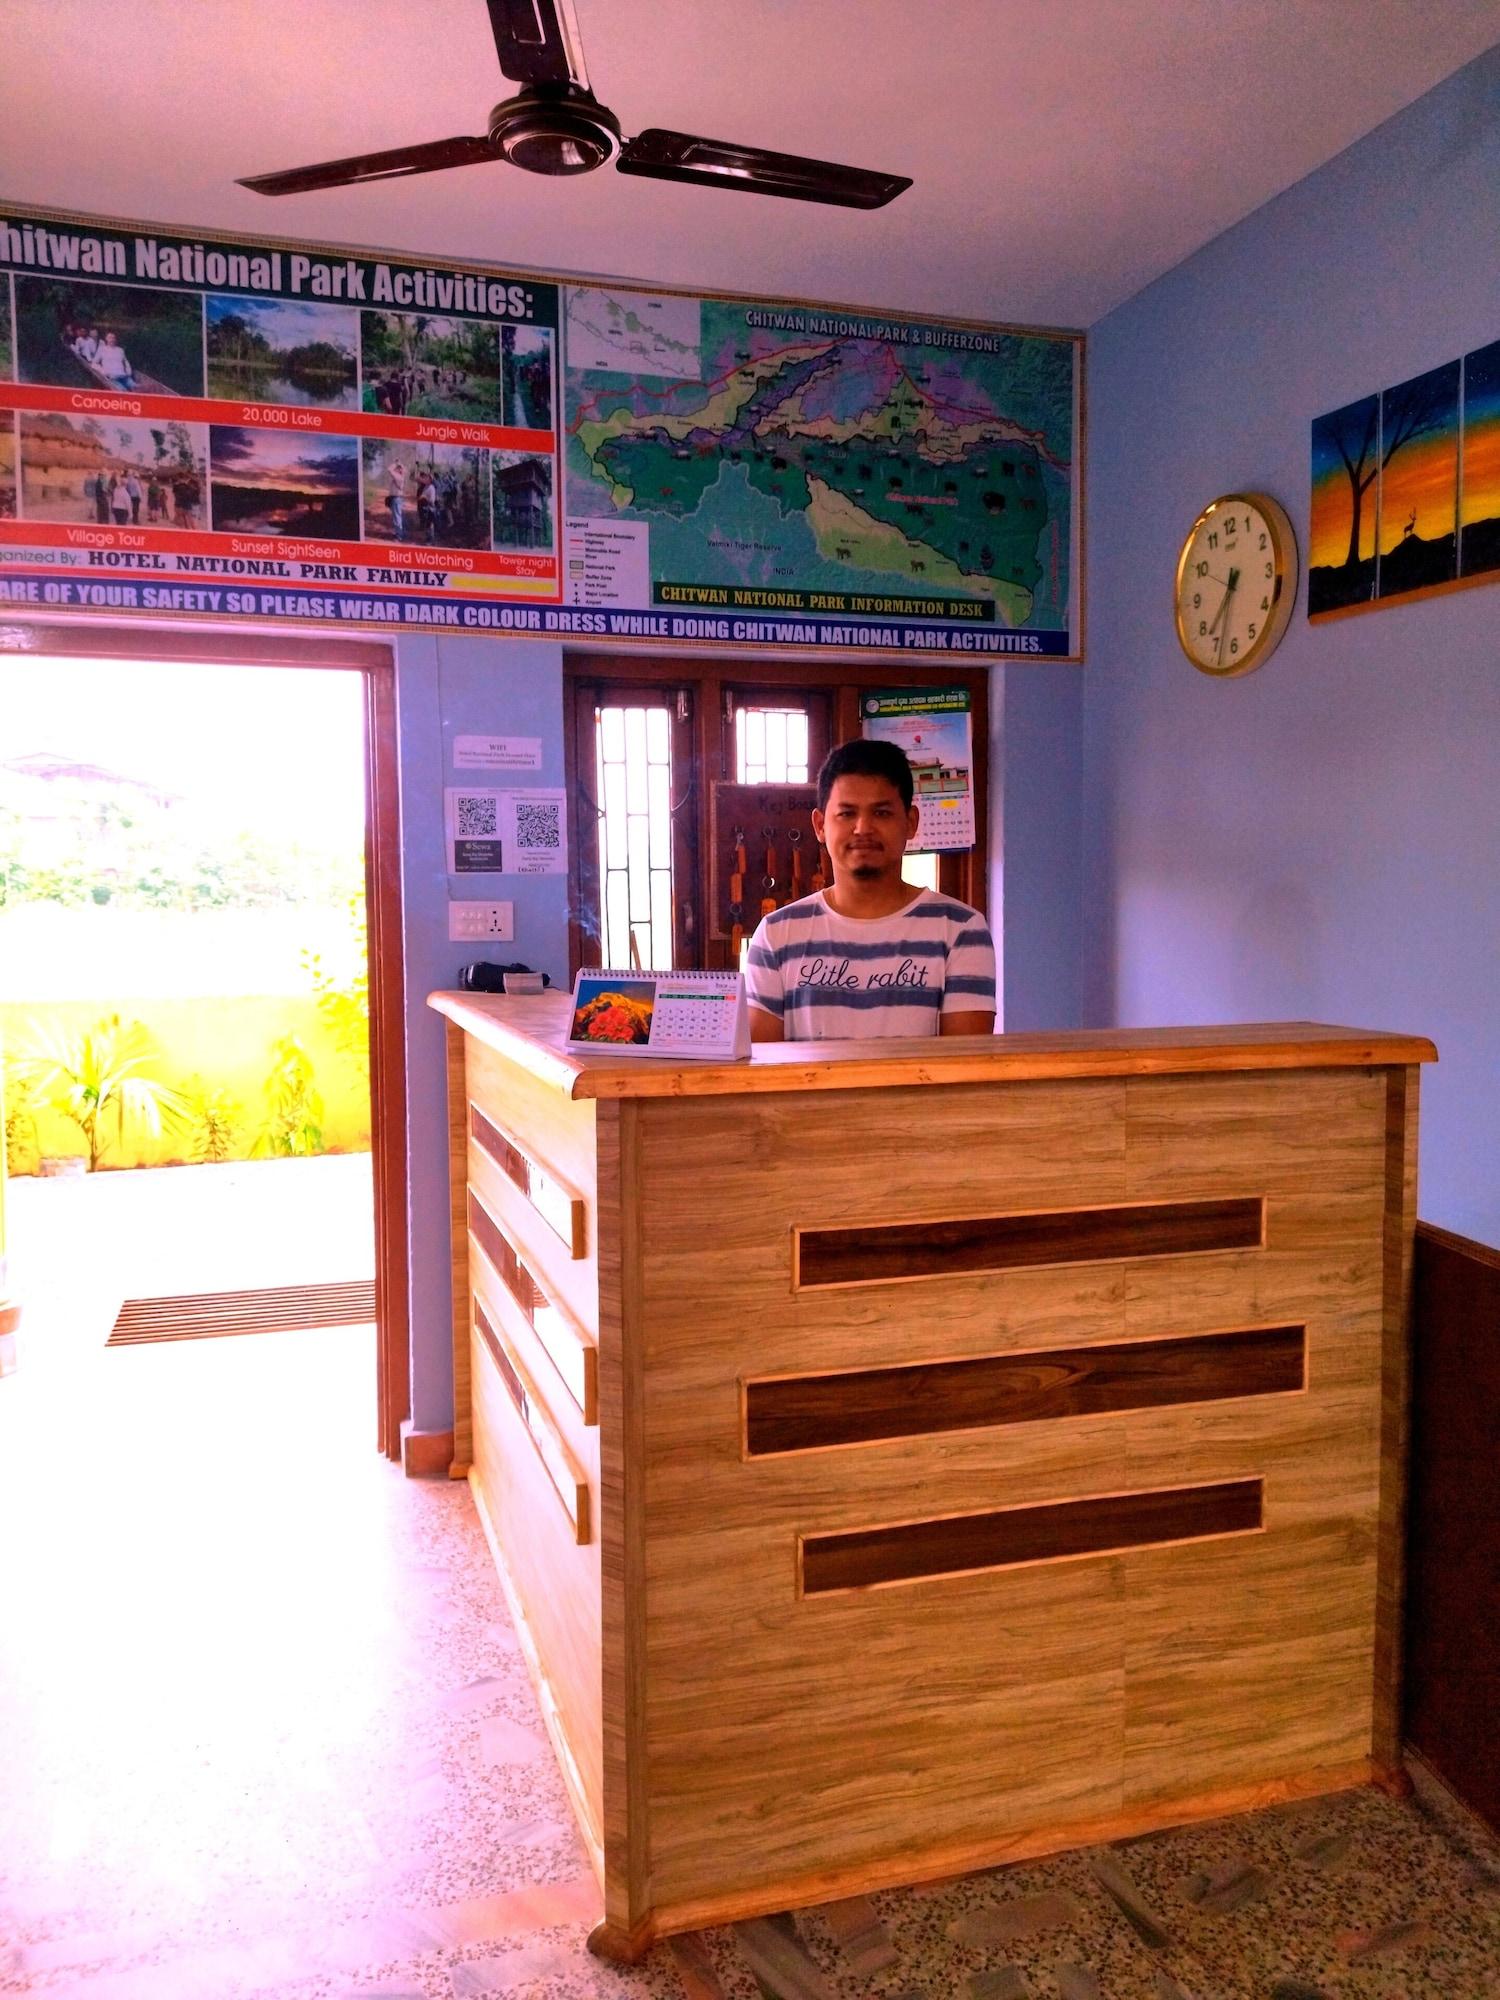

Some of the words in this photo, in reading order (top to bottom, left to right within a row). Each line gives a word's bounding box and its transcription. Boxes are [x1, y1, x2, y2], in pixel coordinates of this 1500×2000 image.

[135, 238, 282, 291] National
[291, 254, 367, 300] Park
[373, 264, 534, 318] Activities:
[745, 310, 806, 331] CHITWAN
[810, 318, 874, 339] NATIONAL
[876, 325, 908, 344] PARK
[911, 329, 921, 345] &
[924, 331, 1000, 353] BUFFERZONE
[71, 394, 141, 415] Canoeing
[291, 410, 322, 427] Lake
[415, 423, 457, 441] Jungle
[461, 428, 490, 442] Walk
[1223, 517, 1236, 535] 12
[1244, 516, 1250, 532] 1
[67, 529, 115, 547] Village
[118, 531, 146, 547] Tour
[1207, 532, 1219, 550] 11
[1259, 533, 1267, 551] 2
[231, 538, 274, 555] Sunset
[278, 543, 341, 560] SightSeen
[88, 551, 166, 569] HOTEL
[176, 555, 291, 577] NATIONAL
[300, 563, 359, 581] PARK
[367, 568, 448, 587] FAMILY
[388, 550, 413, 565] Bird
[414, 552, 474, 571] Watching
[499, 555, 526, 567] Tower
[527, 557, 552, 569] night
[1196, 561, 1209, 577] 10
[515, 565, 537, 578] Stay
[773, 567, 795, 576] INDIA
[1265, 562, 1273, 579] 3
[661, 586, 728, 604] CHITWAN
[734, 591, 804, 607] NATIONAL
[809, 594, 846, 610] PARK
[851, 597, 945, 616] INFORMATION
[949, 601, 983, 617] DESK
[1193, 594, 1201, 608] 9
[1260, 596, 1269, 612] 4
[44, 583, 73, 603] OF
[77, 584, 137, 608] YOUR
[142, 589, 223, 611] SAFETY
[226, 593, 256, 613] SO
[260, 594, 335, 618] PLEASE
[340, 599, 400, 622] WEAR
[405, 603, 459, 625] DARK
[463, 606, 541, 629] COLOUR
[545, 611, 607, 633] DRESS
[610, 615, 669, 636] WHILE
[672, 618, 729, 639] DOING
[733, 622, 816, 643] CHITWAN
[820, 626, 901, 647] NATIONAL
[904, 630, 948, 649] PARK
[951, 634, 1043, 653] ACTIVITIES.
[1200, 621, 1207, 636] 8
[1248, 623, 1256, 639] 5
[1213, 637, 1220, 653] 7
[1230, 638, 1238, 654] 6
[866, 958, 928, 988] rabit
